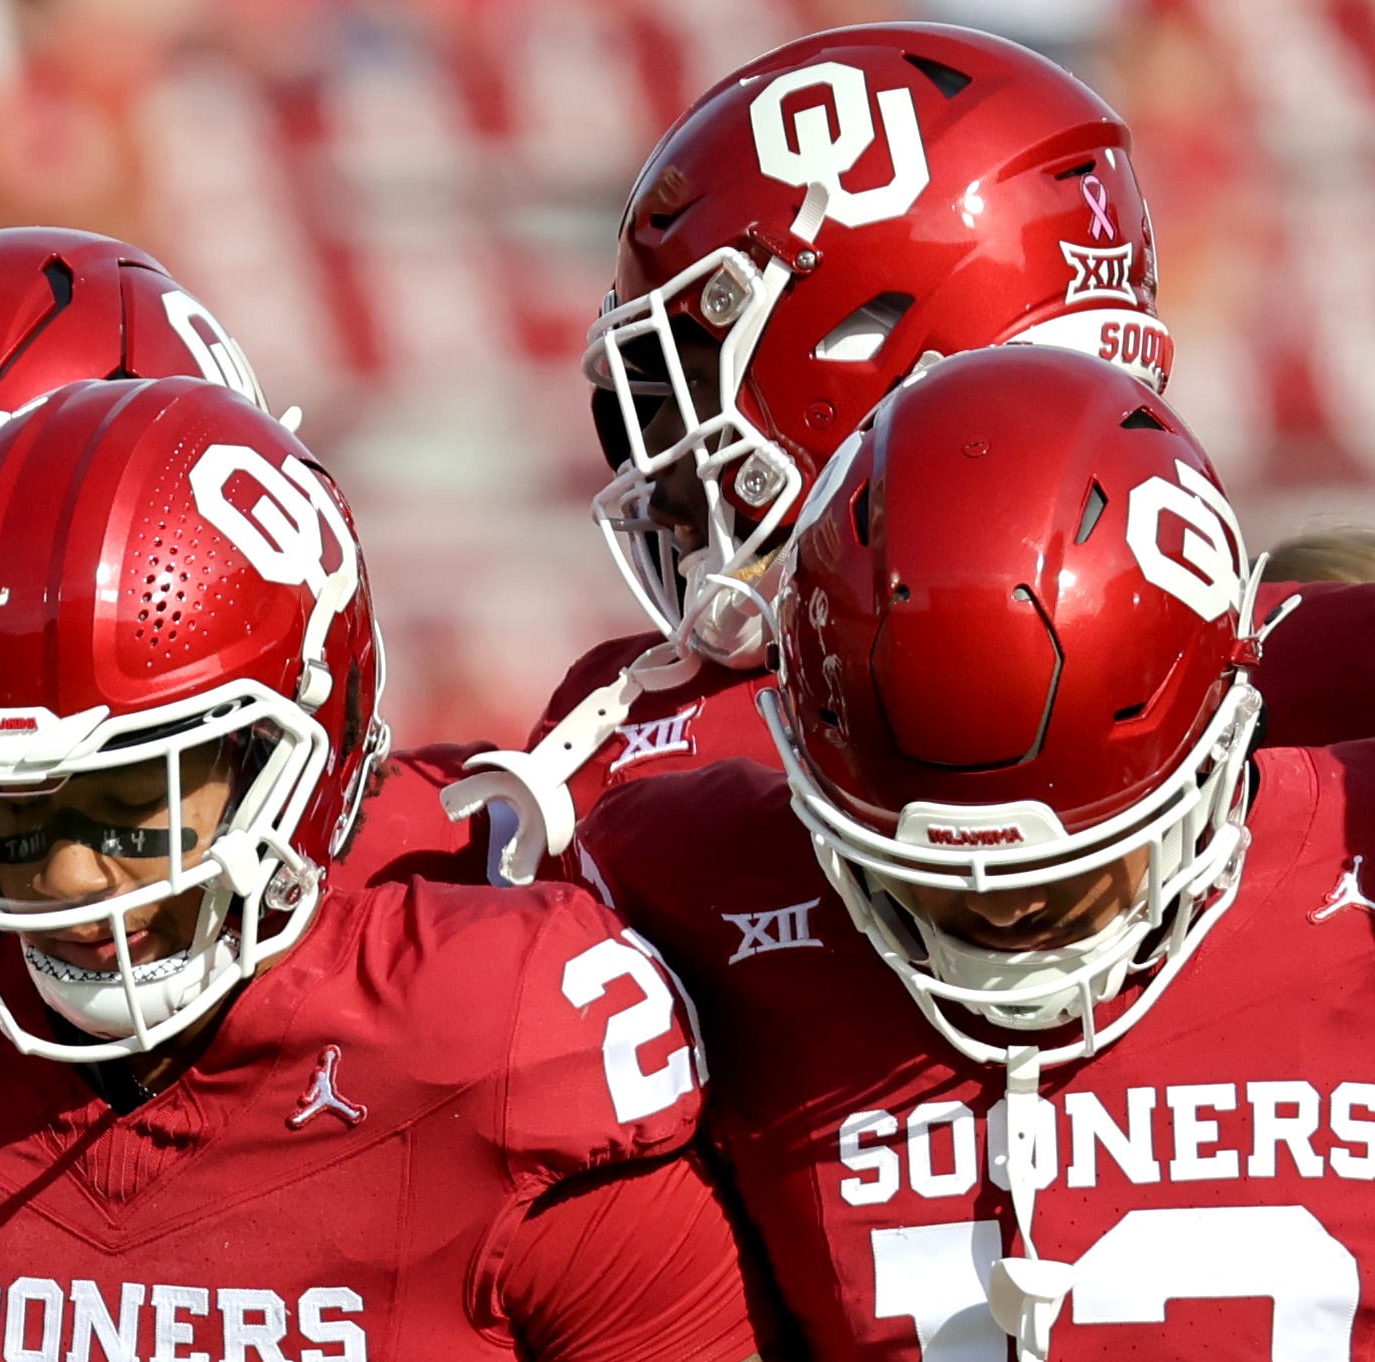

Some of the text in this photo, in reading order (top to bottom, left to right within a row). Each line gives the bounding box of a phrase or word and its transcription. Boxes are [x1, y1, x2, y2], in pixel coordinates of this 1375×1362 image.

[748, 61, 931, 227] OU
[1063, 243, 1134, 301] XII
[188, 443, 357, 612] OU
[610, 703, 698, 772] XII
[721, 897, 824, 966] XII
[839, 1080, 1375, 1206] SOONERS
